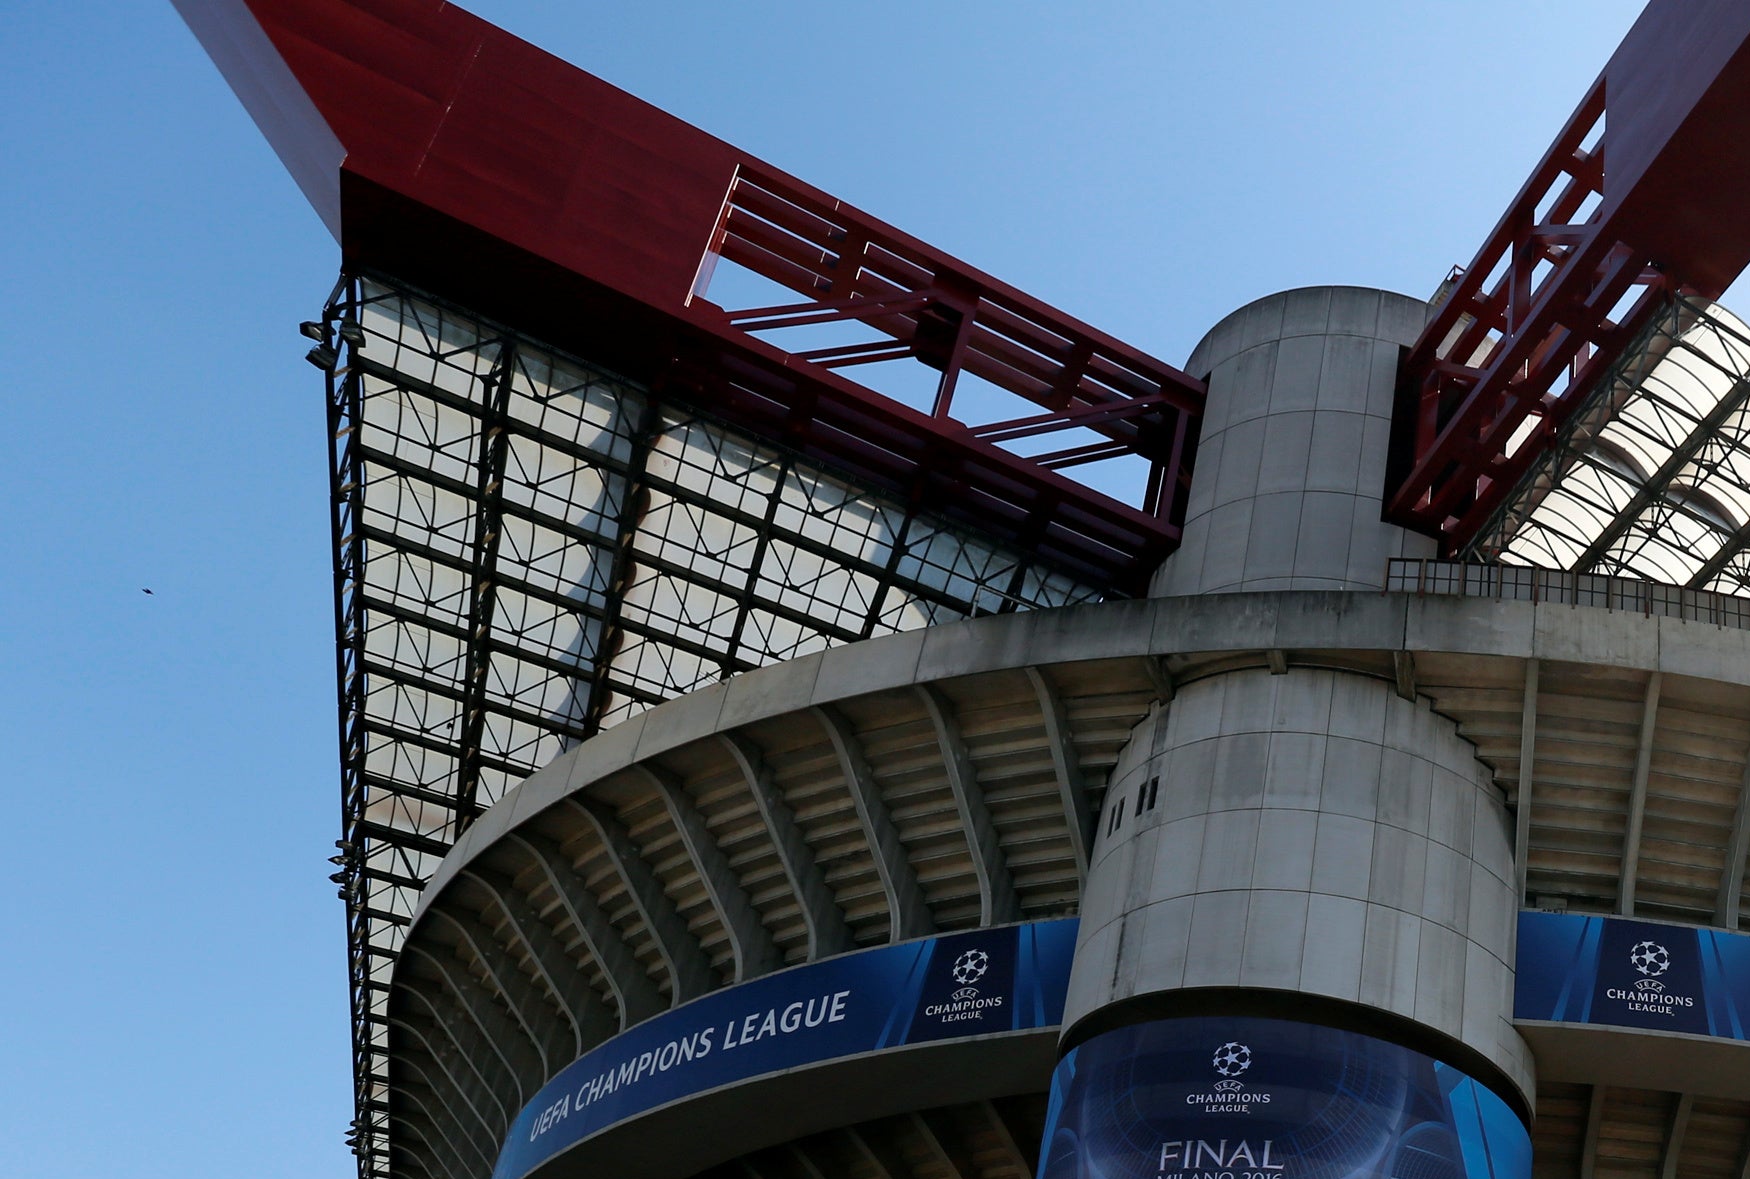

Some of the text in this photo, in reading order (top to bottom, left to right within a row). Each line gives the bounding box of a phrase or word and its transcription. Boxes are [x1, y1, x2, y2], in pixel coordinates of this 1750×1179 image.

[1635, 981, 1663, 992] UEFA
[952, 989, 977, 1000] UEFA
[1606, 988, 1694, 1007] CHAMPIONS
[925, 996, 1003, 1016] CHAMPIONS
[1628, 1002, 1672, 1014] LEAGUE
[941, 1010, 982, 1023] LEAGUE
[530, 990, 850, 1142] UEFA CHAMPIONS LEAGUE
[1214, 1081, 1241, 1091] UEFA
[1186, 1093, 1271, 1105] CHAMPIONS
[1205, 1104, 1248, 1113] LEAGUE
[1159, 1139, 1284, 1171] FINAL
